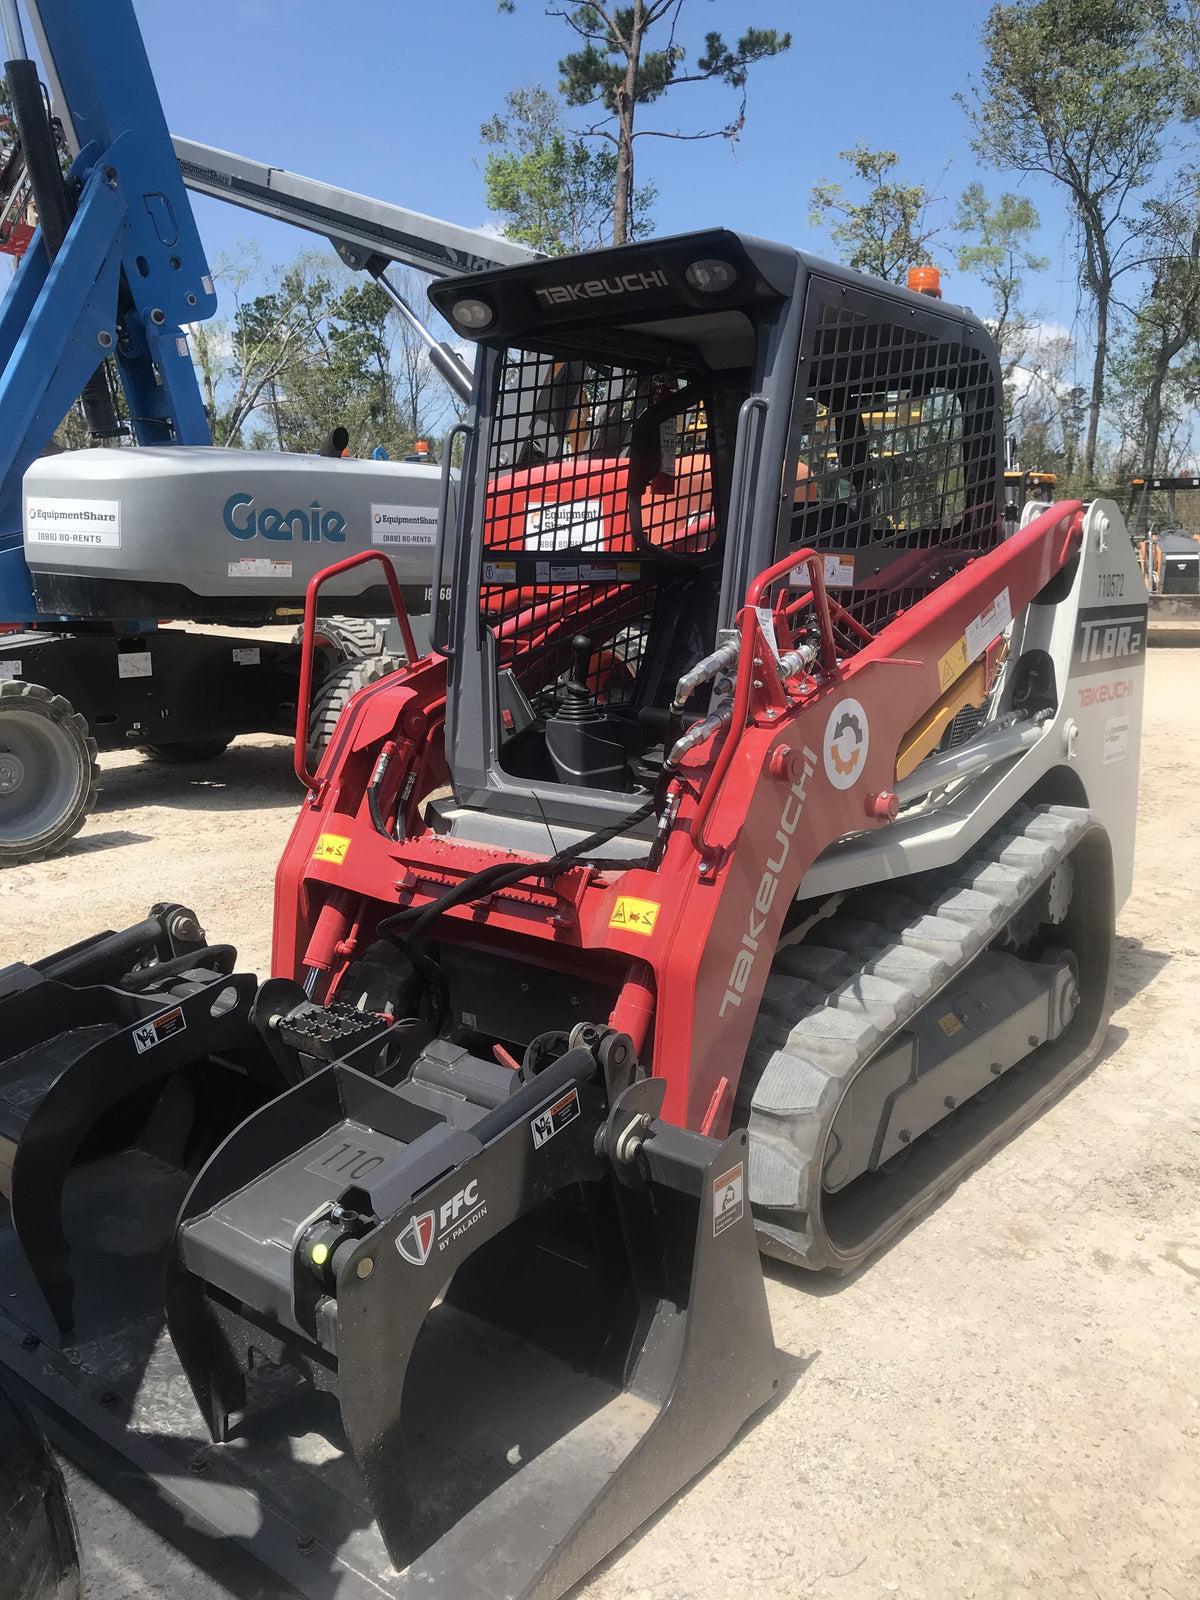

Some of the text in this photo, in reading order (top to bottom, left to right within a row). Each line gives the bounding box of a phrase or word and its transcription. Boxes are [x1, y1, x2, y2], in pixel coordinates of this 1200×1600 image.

[535, 270, 669, 305] TAKEUCHI
[37, 509, 116, 521] EquipmentShare
[223, 493, 347, 543] Genie
[38, 532, 102, 543] (888) 80-RENTS
[383, 534, 432, 543] (888) 80-RENTS
[1098, 573, 1125, 598] 110572
[1078, 679, 1134, 707] TAKEUCHI
[718, 745, 819, 1018] TAKEUCHI
[321, 1143, 385, 1180] 110
[440, 1178, 479, 1230] FFC
[438, 1206, 488, 1251] BY PALADIN
